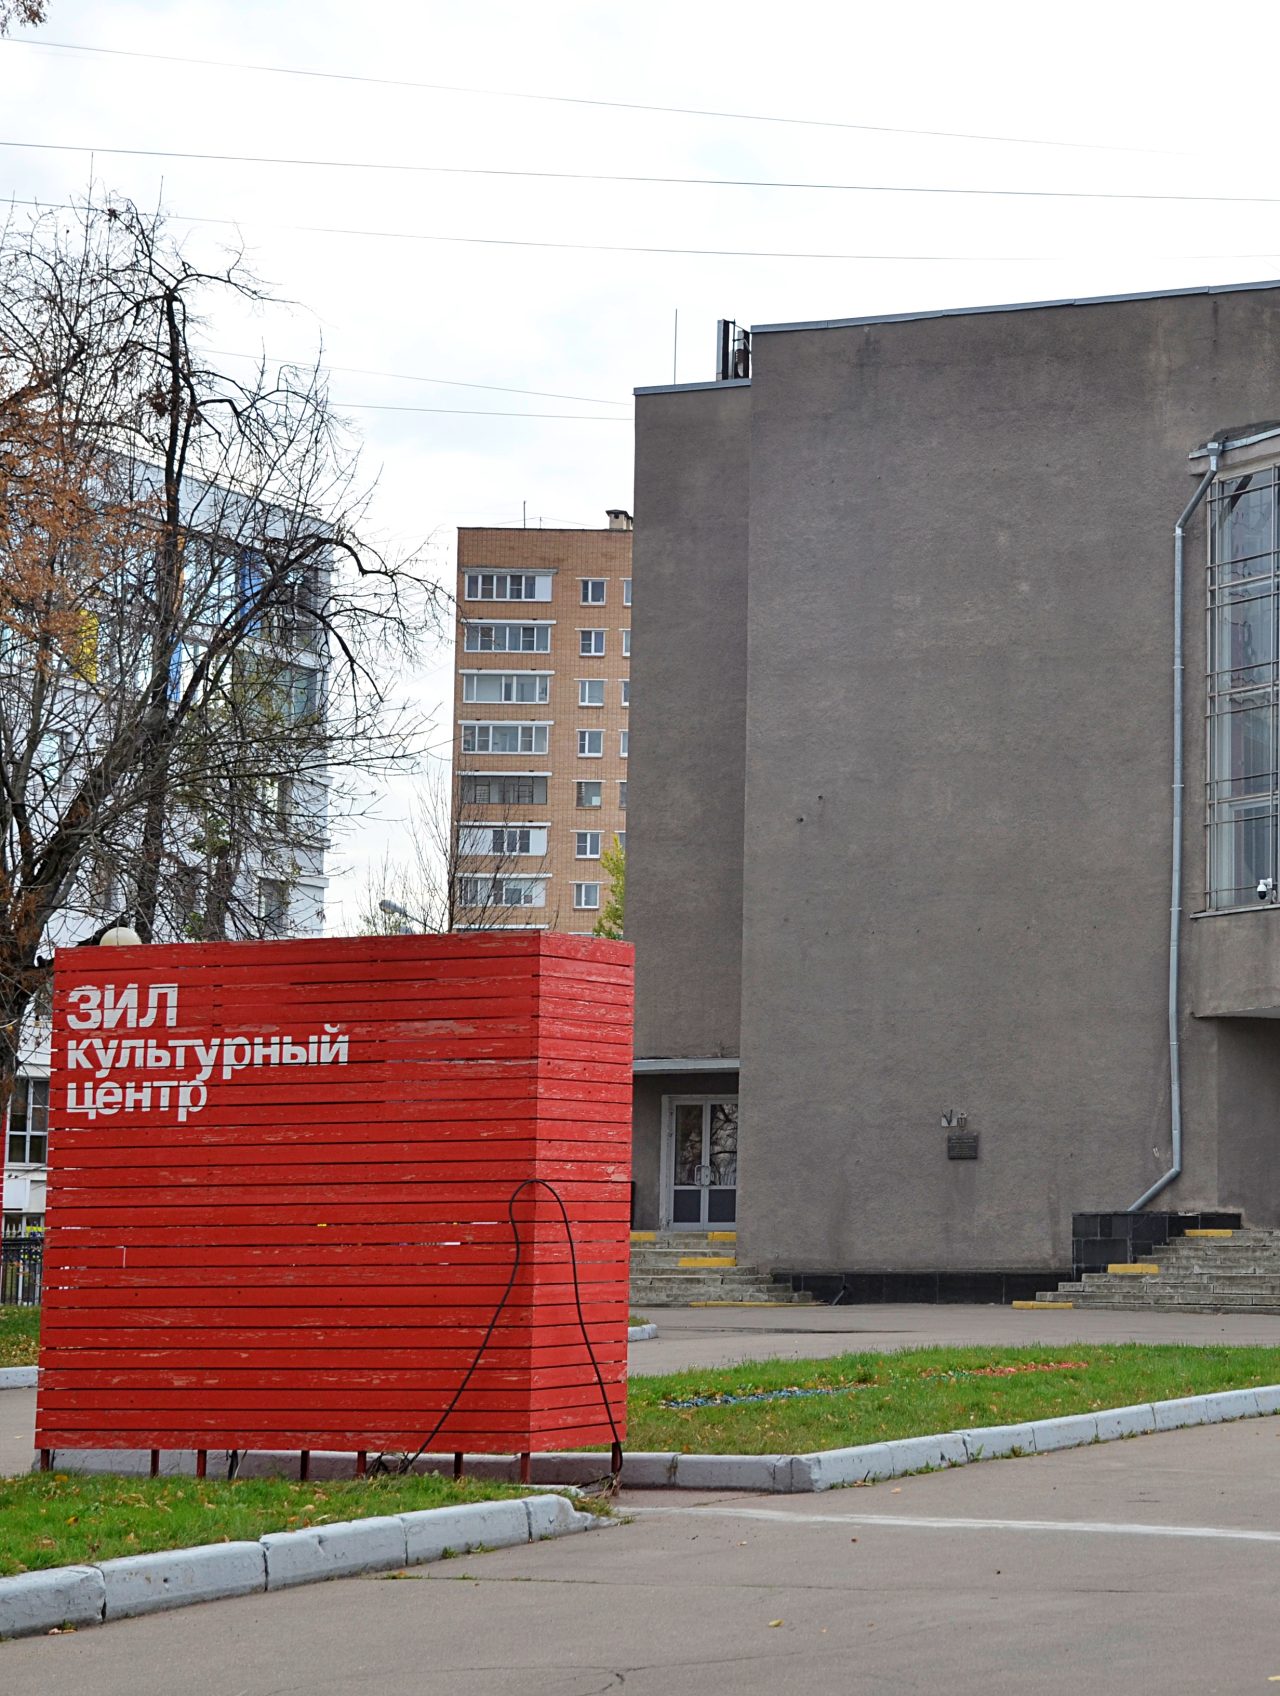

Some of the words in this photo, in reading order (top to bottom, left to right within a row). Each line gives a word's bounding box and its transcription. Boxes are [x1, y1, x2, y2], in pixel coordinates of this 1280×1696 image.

[66, 983, 178, 1029] ЗИЛ
[67, 1024, 349, 1080] культурный
[66, 1080, 207, 1122] центр
